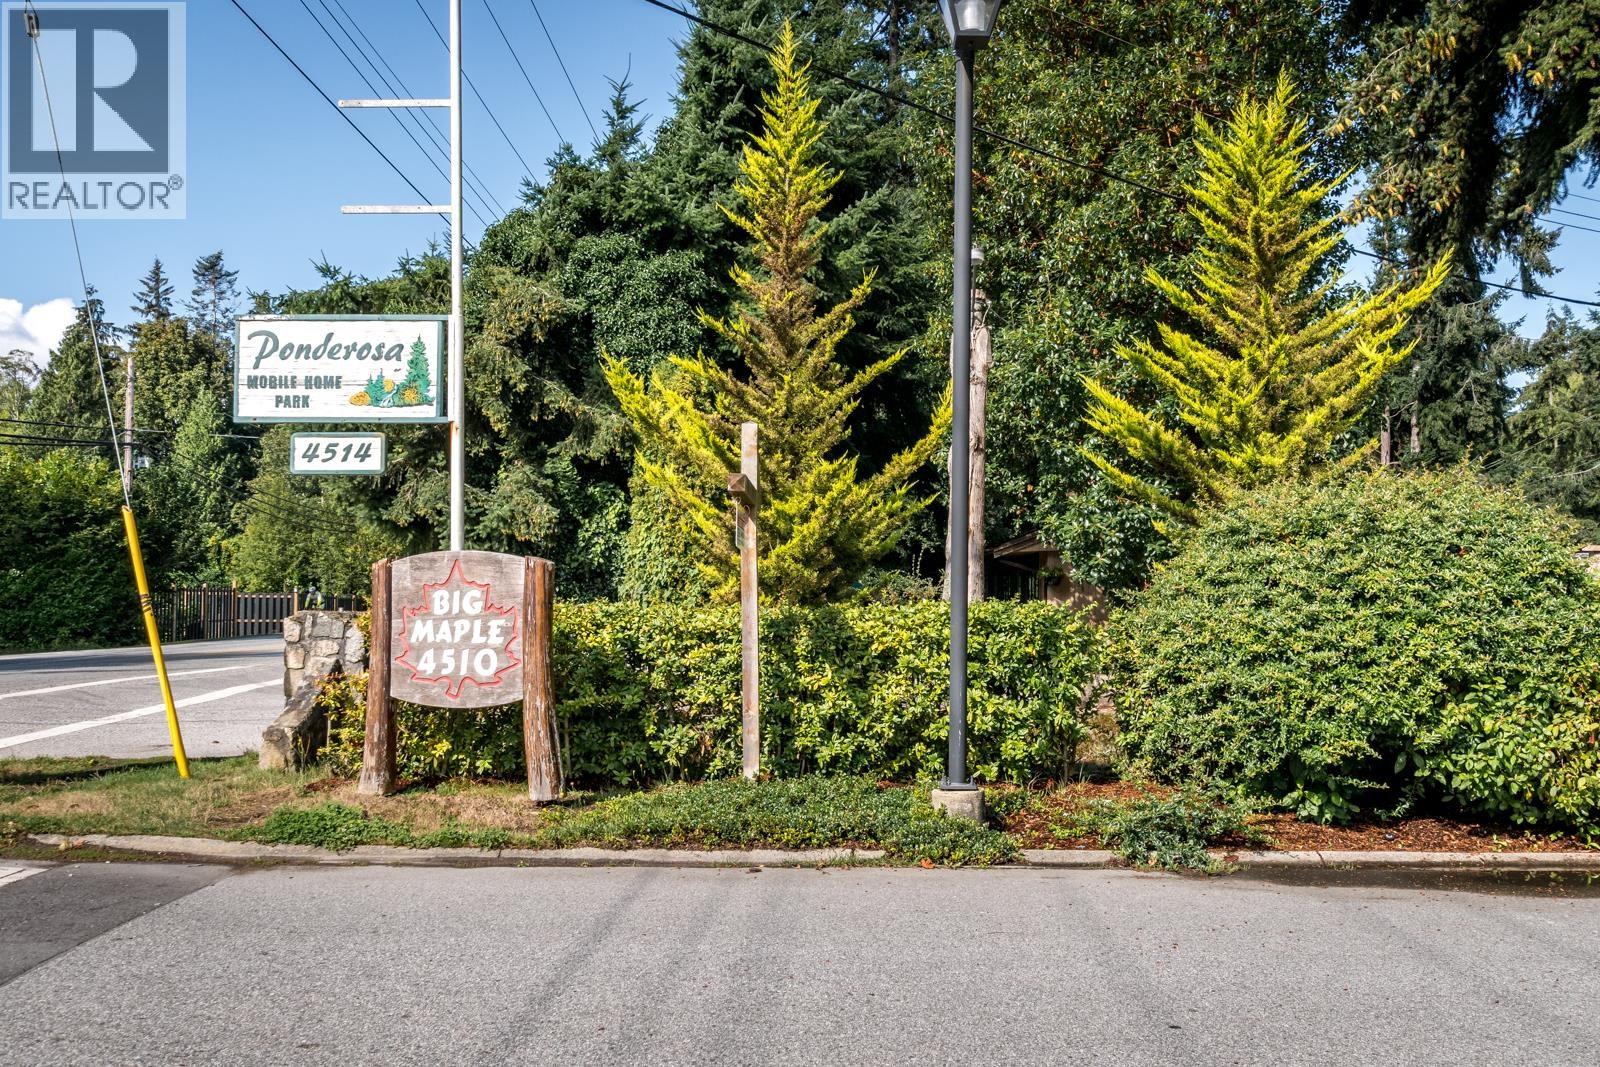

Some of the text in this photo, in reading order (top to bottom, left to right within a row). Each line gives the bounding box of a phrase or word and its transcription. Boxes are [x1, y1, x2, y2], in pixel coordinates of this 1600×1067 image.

[247, 329, 405, 370] Ponderosa
[246, 375, 343, 390] MOBILE HOME
[274, 395, 310, 408] PARK
[301, 442, 373, 463] 4514
[432, 589, 484, 615] BIG
[410, 619, 506, 644] MAPLE
[416, 647, 498, 676] 4510
